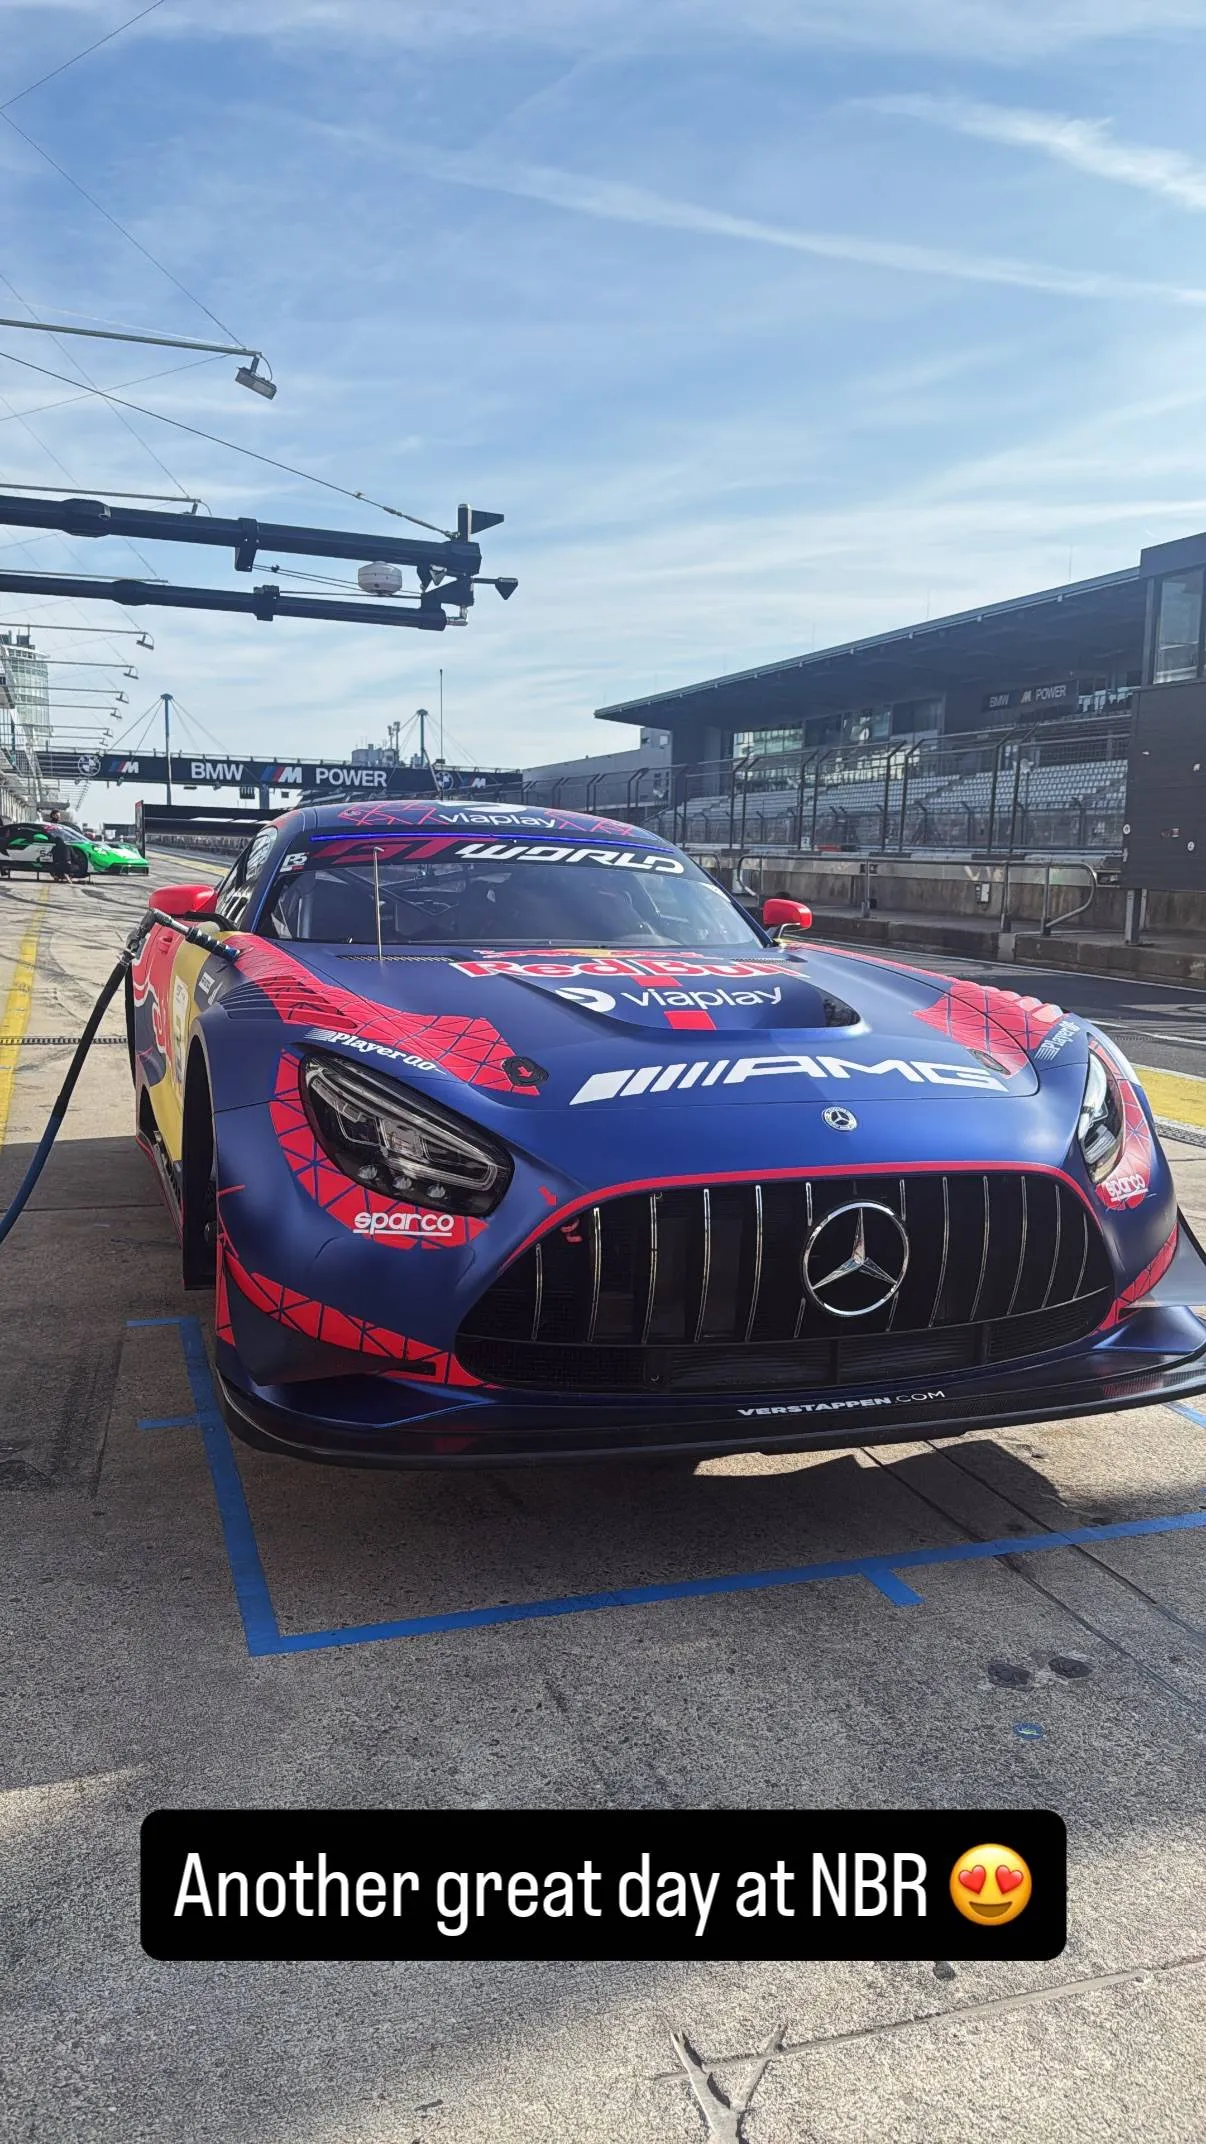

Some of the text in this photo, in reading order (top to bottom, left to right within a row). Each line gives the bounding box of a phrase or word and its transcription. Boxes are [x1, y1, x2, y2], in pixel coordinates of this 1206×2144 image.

[990, 694, 1010, 708] BMW
[1035, 685, 1067, 700] POWER
[190, 761, 244, 781] BMW
[315, 768, 388, 787] POWER
[439, 812, 556, 829] viaplay
[312, 836, 685, 874] GT WORLD
[449, 958, 810, 979] Red Bull
[620, 986, 782, 1010] viaplay
[722, 1055, 1010, 1092] AMG
[1106, 1174, 1147, 1198] sparco
[353, 1211, 455, 1240] sparco
[737, 1390, 946, 1417] VERSTAPPEN.COM
